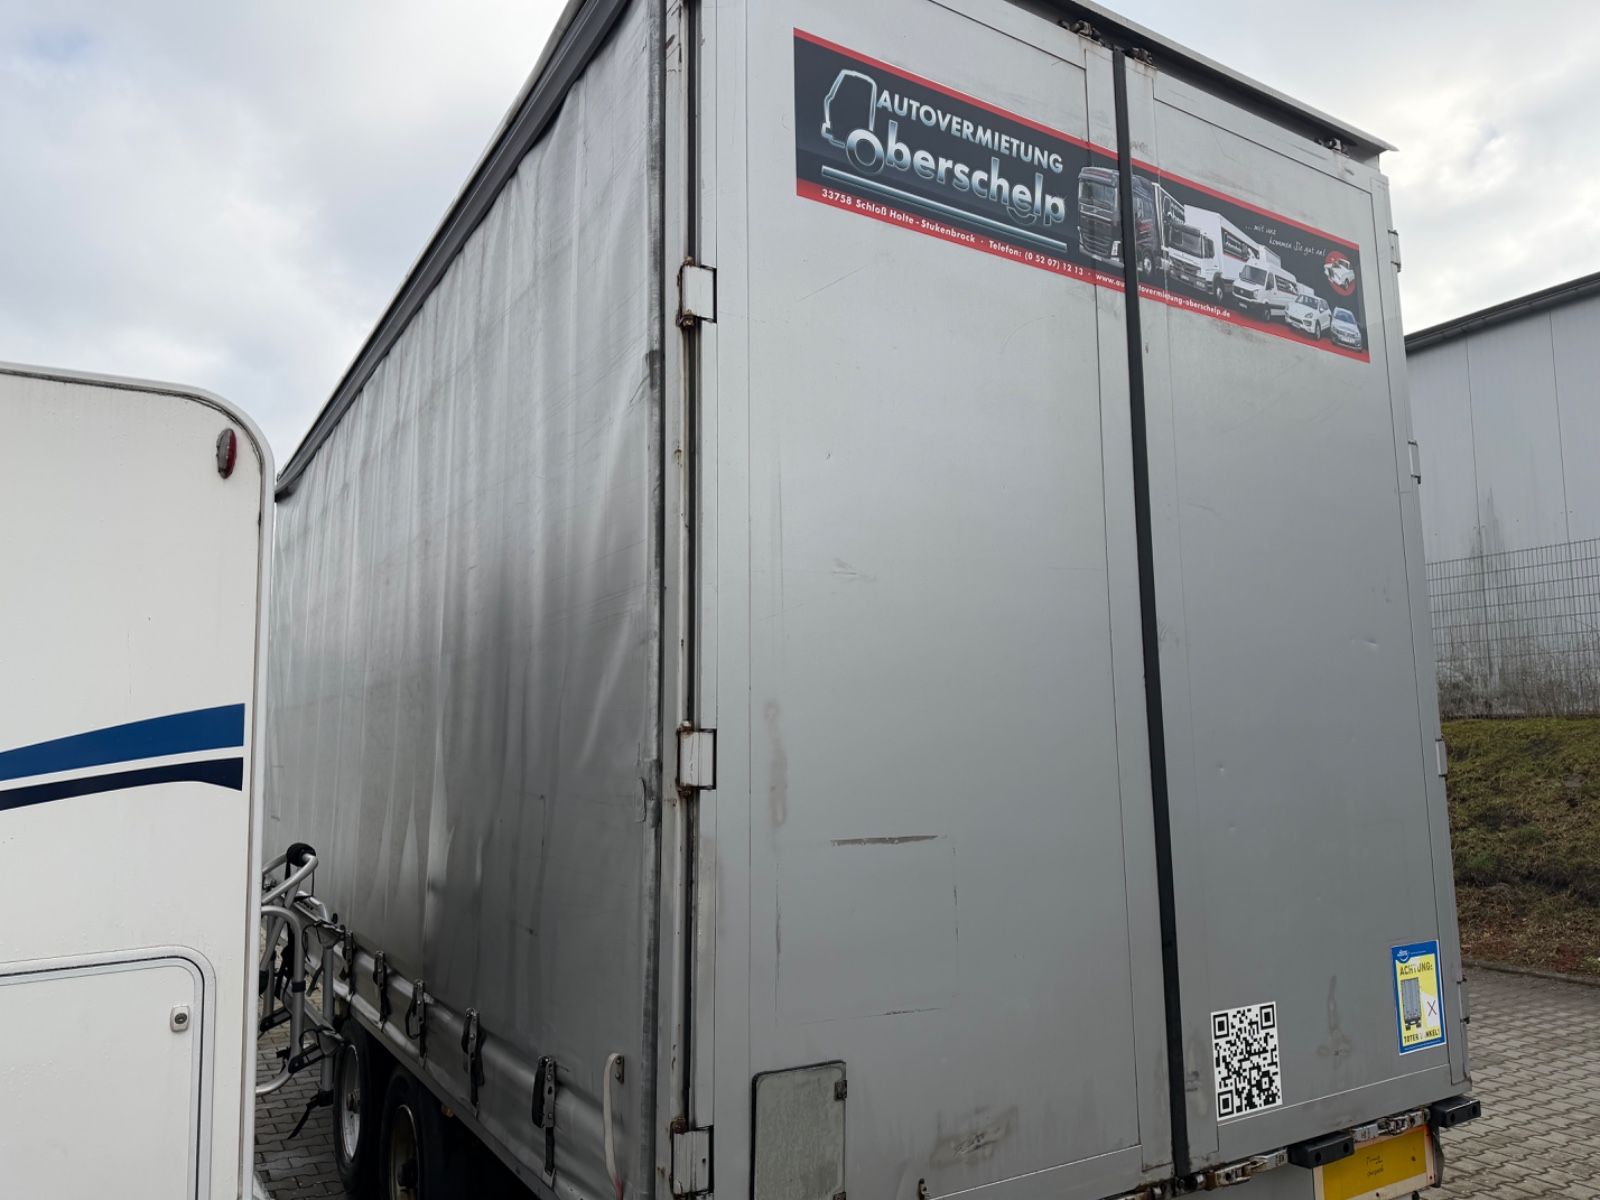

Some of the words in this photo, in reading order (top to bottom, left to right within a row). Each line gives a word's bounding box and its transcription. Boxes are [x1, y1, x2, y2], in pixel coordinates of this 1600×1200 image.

[846, 120, 1066, 226] Oberschelp
[877, 90, 1064, 174] AUTOVERMIETUNG
[821, 188, 852, 206] 33758
[856, 199, 887, 217] Schloß
[889, 210, 914, 225] Holte
[920, 219, 976, 243] Stukenbrock
[988, 240, 1022, 257] Telefon:
[1035, 254, 1045, 265] 52
[1047, 258, 1060, 270] 07)
[1074, 265, 1084, 276] 13
[1403, 1033, 1419, 1044] TOTER
